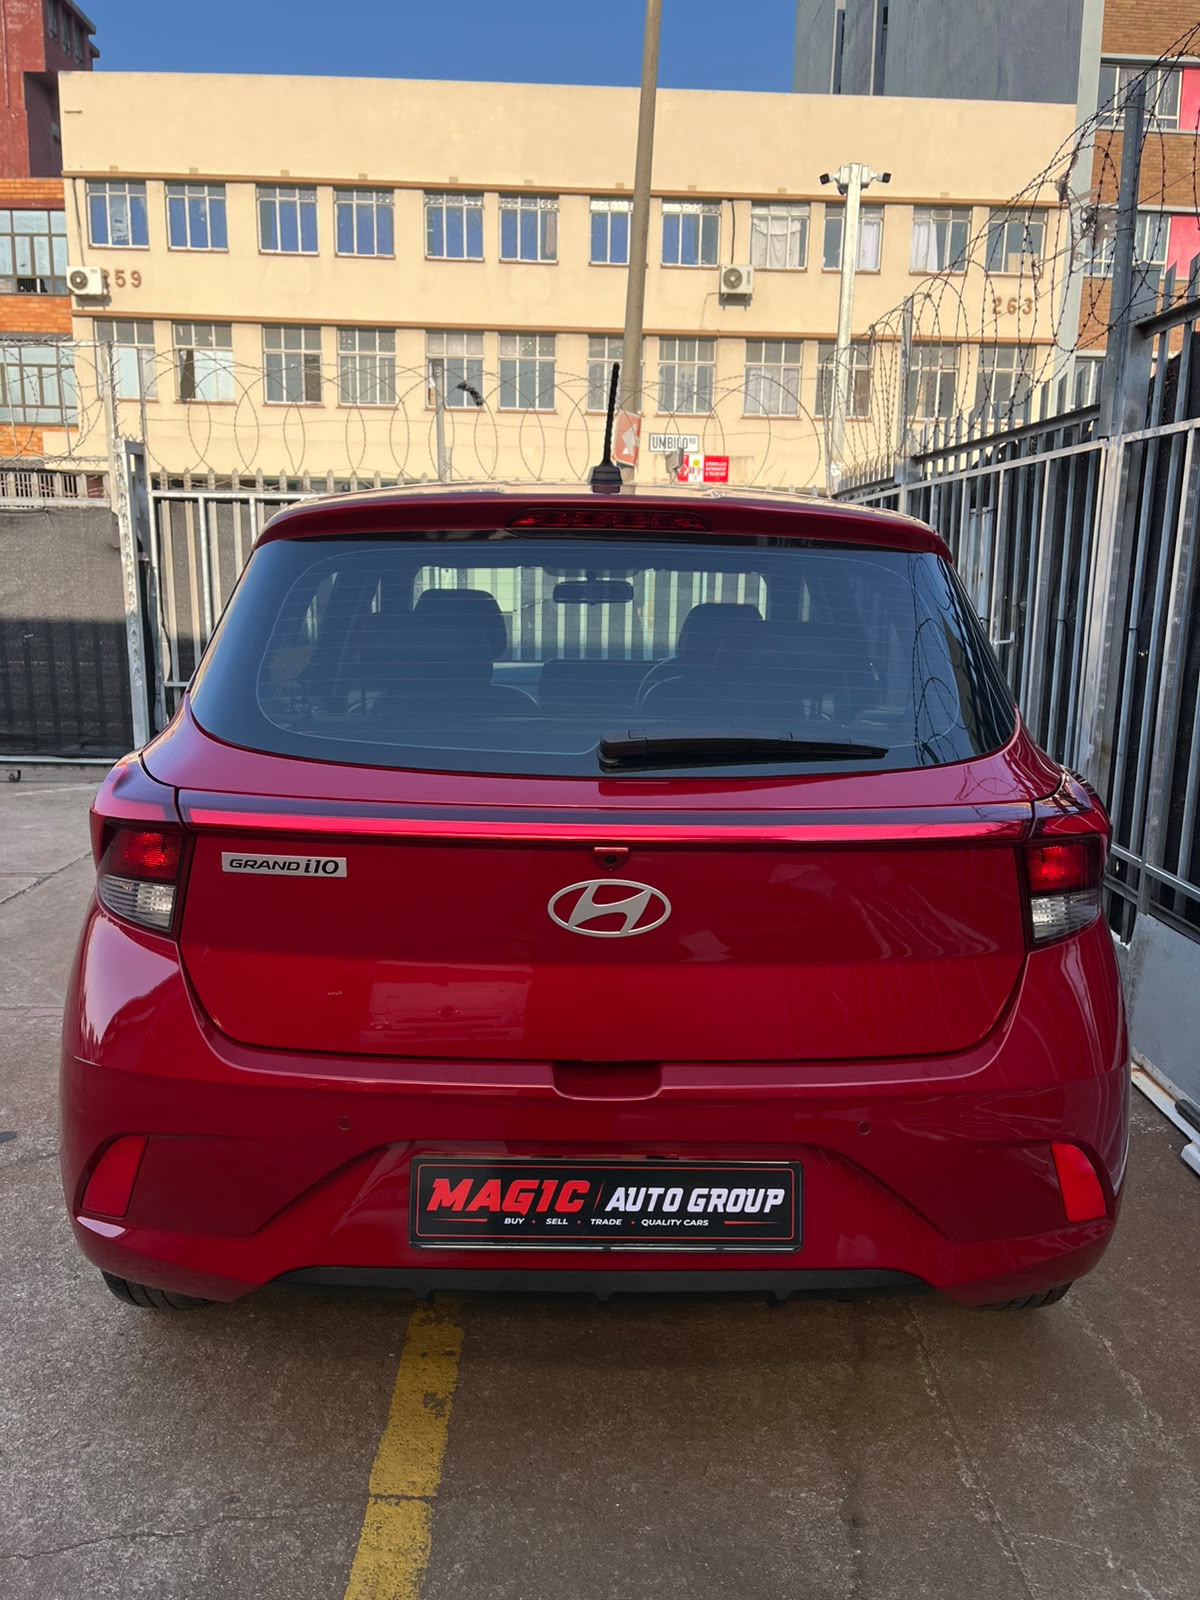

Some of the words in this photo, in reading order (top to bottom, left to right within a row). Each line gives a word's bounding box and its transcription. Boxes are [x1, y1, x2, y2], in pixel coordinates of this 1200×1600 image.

[993, 296, 1033, 315] 263
[652, 436, 689, 449] UMBILO
[229, 859, 300, 871] GRAND
[304, 859, 340, 875] i10
[426, 1178, 591, 1216] MAGIC
[605, 1187, 684, 1212] AUTO
[686, 1188, 785, 1213] GROUP
[504, 1217, 526, 1225] BUY
[545, 1217, 569, 1225] SELL
[590, 1218, 623, 1226] TRADE
[641, 1218, 682, 1227] QUALITY
[683, 1219, 710, 1227] CARS
